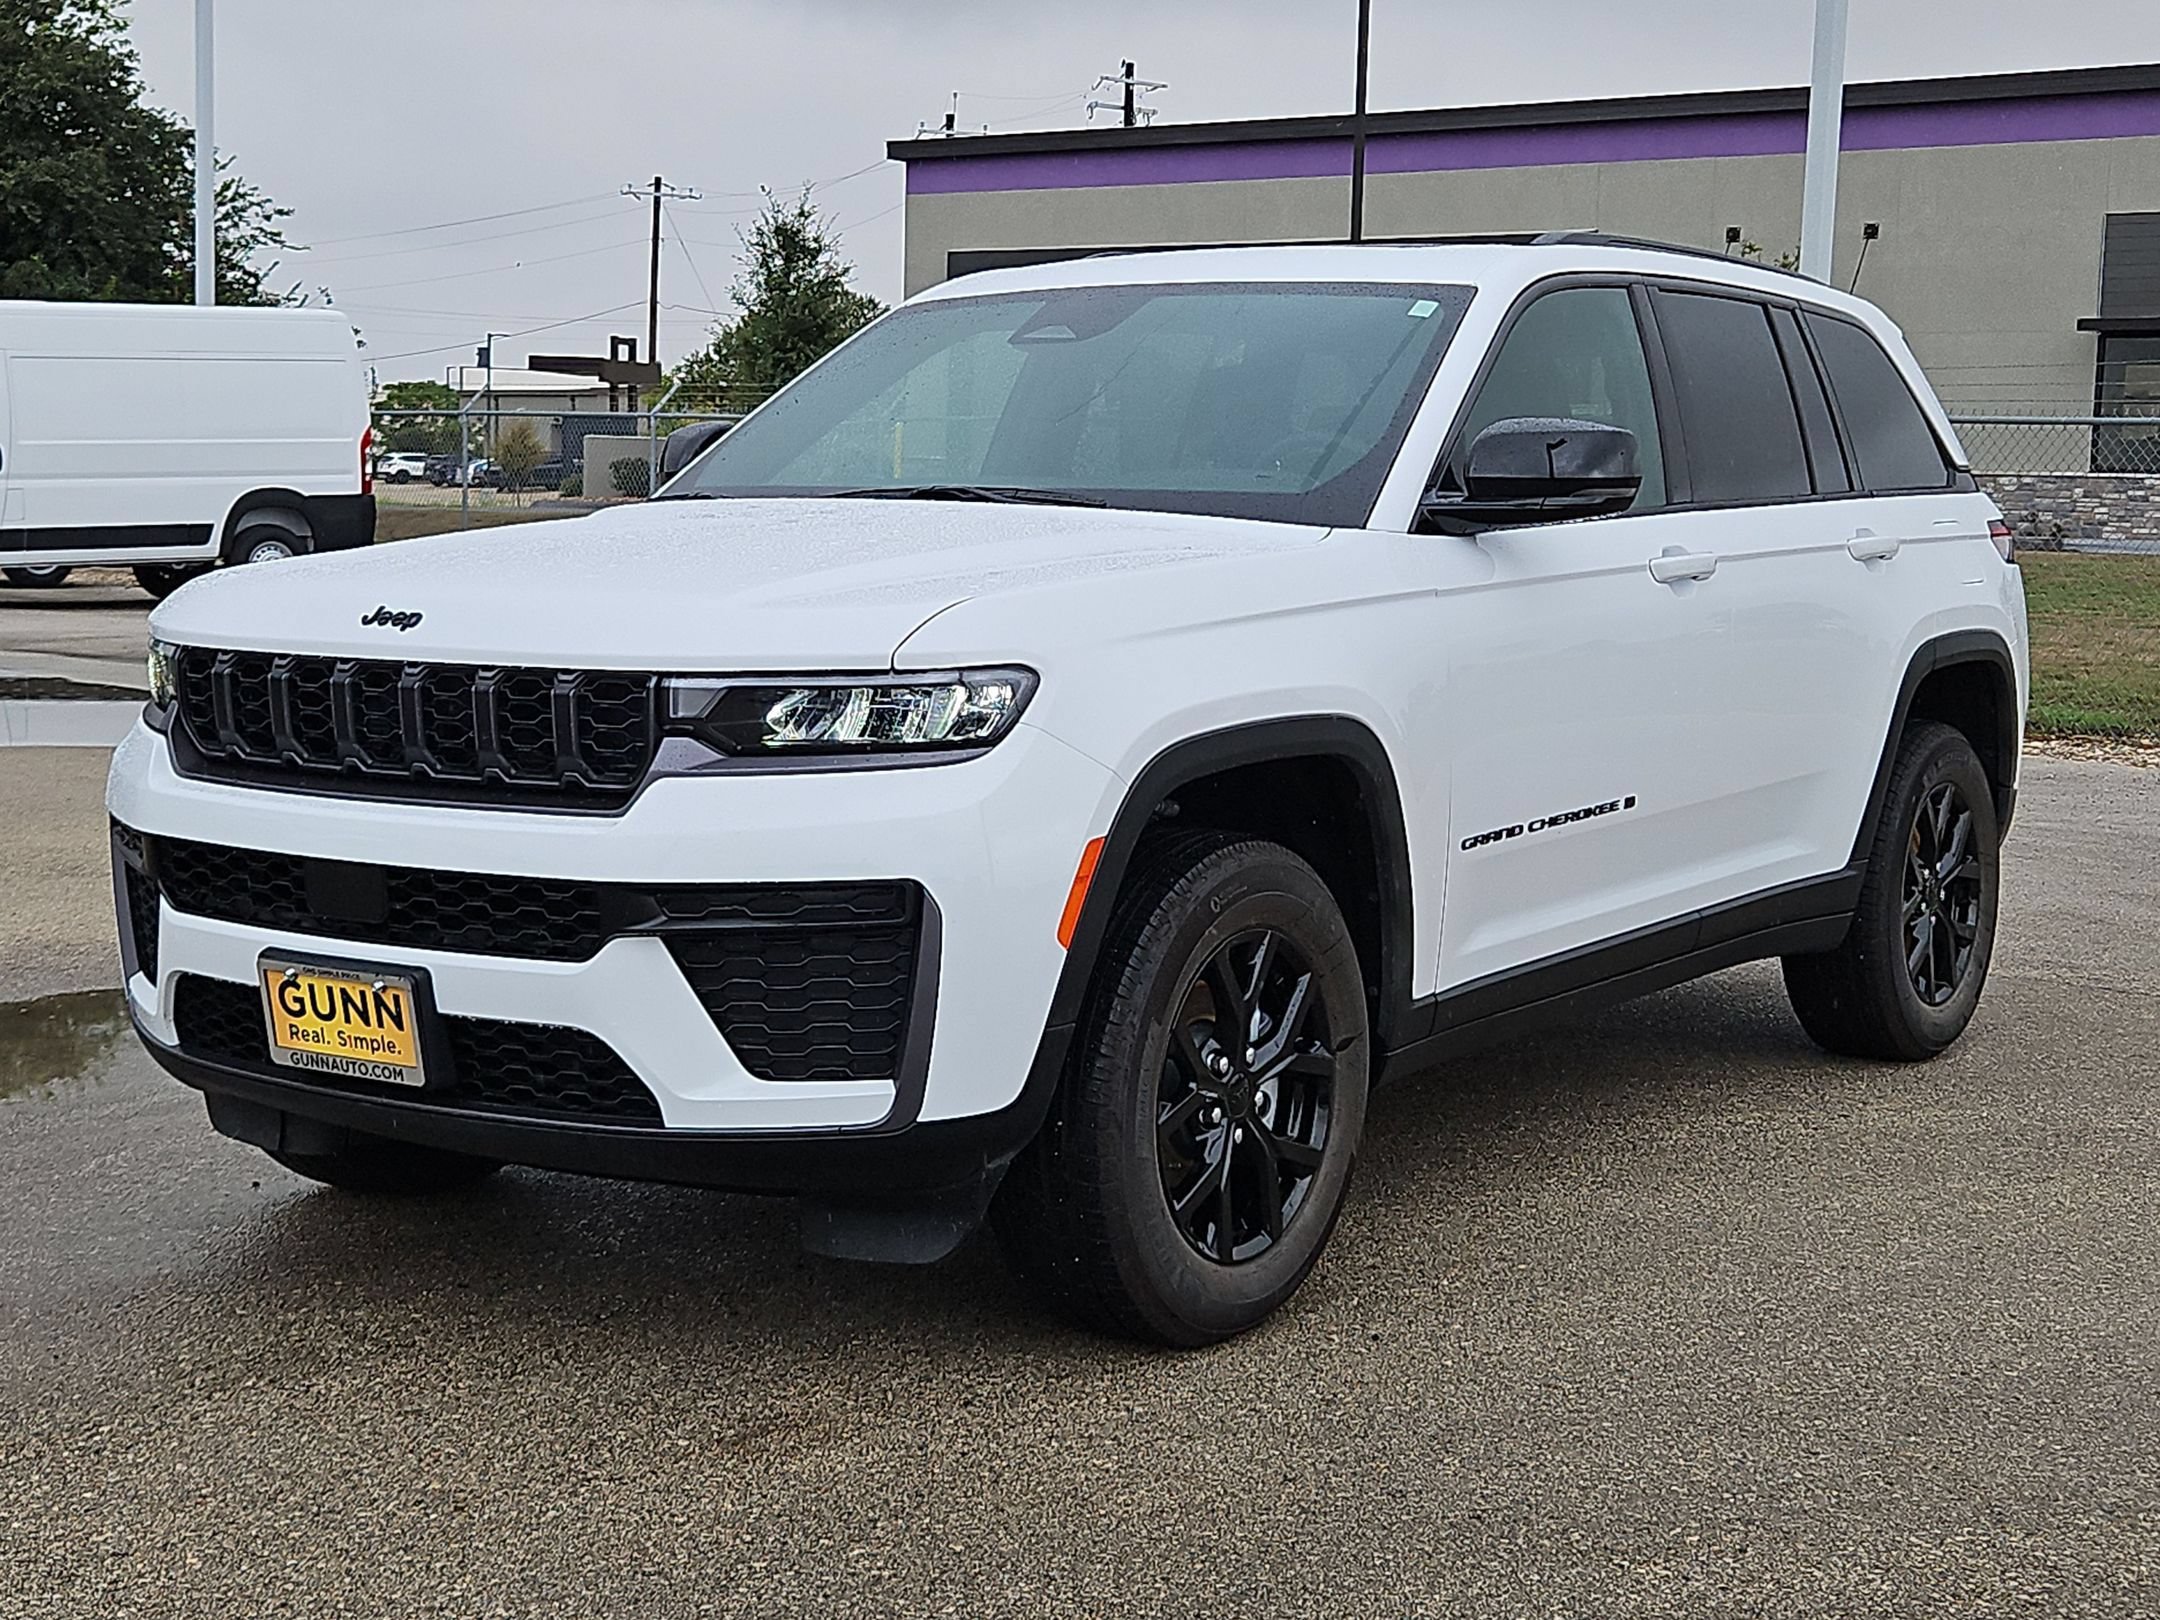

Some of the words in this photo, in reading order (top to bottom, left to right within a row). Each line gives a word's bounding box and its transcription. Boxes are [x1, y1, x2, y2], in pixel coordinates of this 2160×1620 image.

[361, 605, 423, 632] Jeep
[1461, 824, 1524, 851] GRAND
[1528, 799, 1620, 834] CHEROKEE
[277, 980, 405, 1032] GUNN
[289, 1023, 331, 1046] Real.
[289, 1052, 405, 1082] GUNNAUTO.COM
